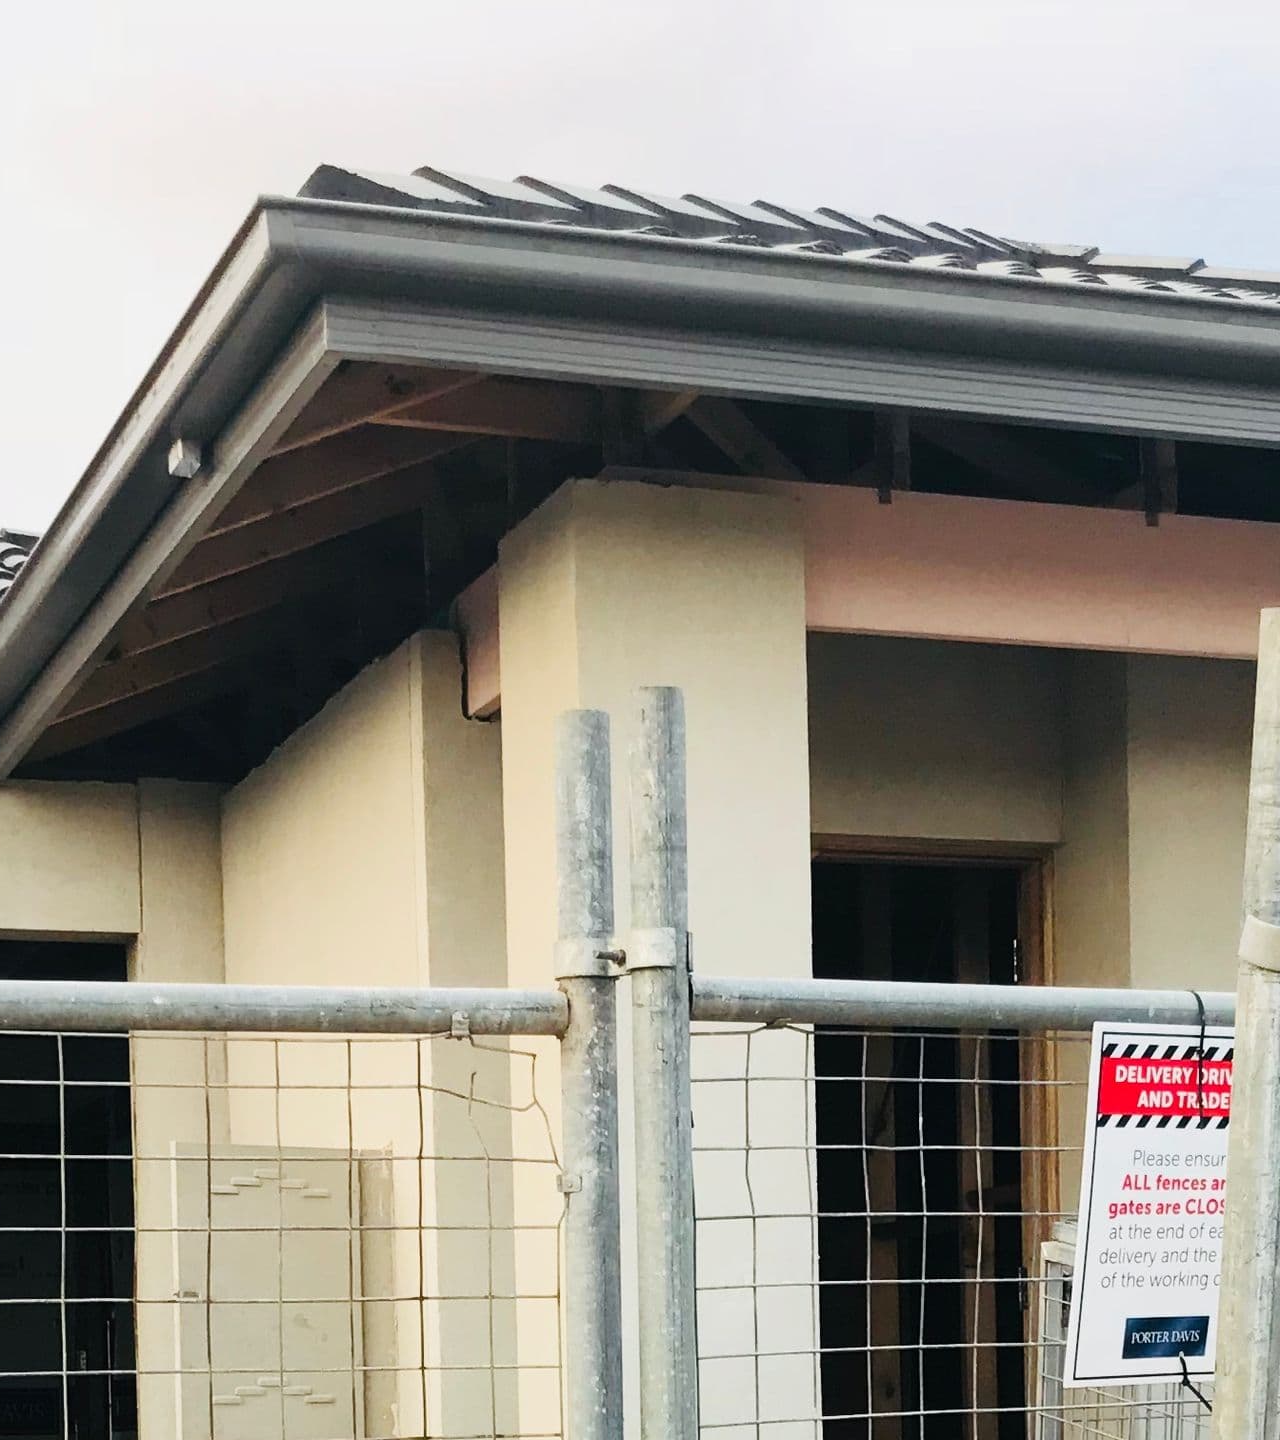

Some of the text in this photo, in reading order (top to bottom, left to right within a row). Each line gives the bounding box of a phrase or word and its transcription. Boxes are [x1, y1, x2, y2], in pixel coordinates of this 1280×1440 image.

[1115, 1064, 1193, 1085] DELIVERY
[1137, 1090, 1230, 1110] AND TRADE
[1133, 1150, 1226, 1167] Please ensur
[1122, 1174, 1151, 1190] ALL
[1157, 1174, 1207, 1190] fences
[1109, 1200, 1151, 1219] gates
[1156, 1203, 1181, 1215] are
[1109, 1226, 1123, 1240] at
[1128, 1223, 1152, 1240] the
[1156, 1224, 1185, 1239] end
[1189, 1222, 1206, 1239] of
[1099, 1247, 1217, 1267] delivery and the
[1101, 1271, 1118, 1288] of
[1121, 1271, 1145, 1288] the
[1150, 1271, 1209, 1290] working
[1131, 1329, 1200, 1344] PORTER DAVIS
